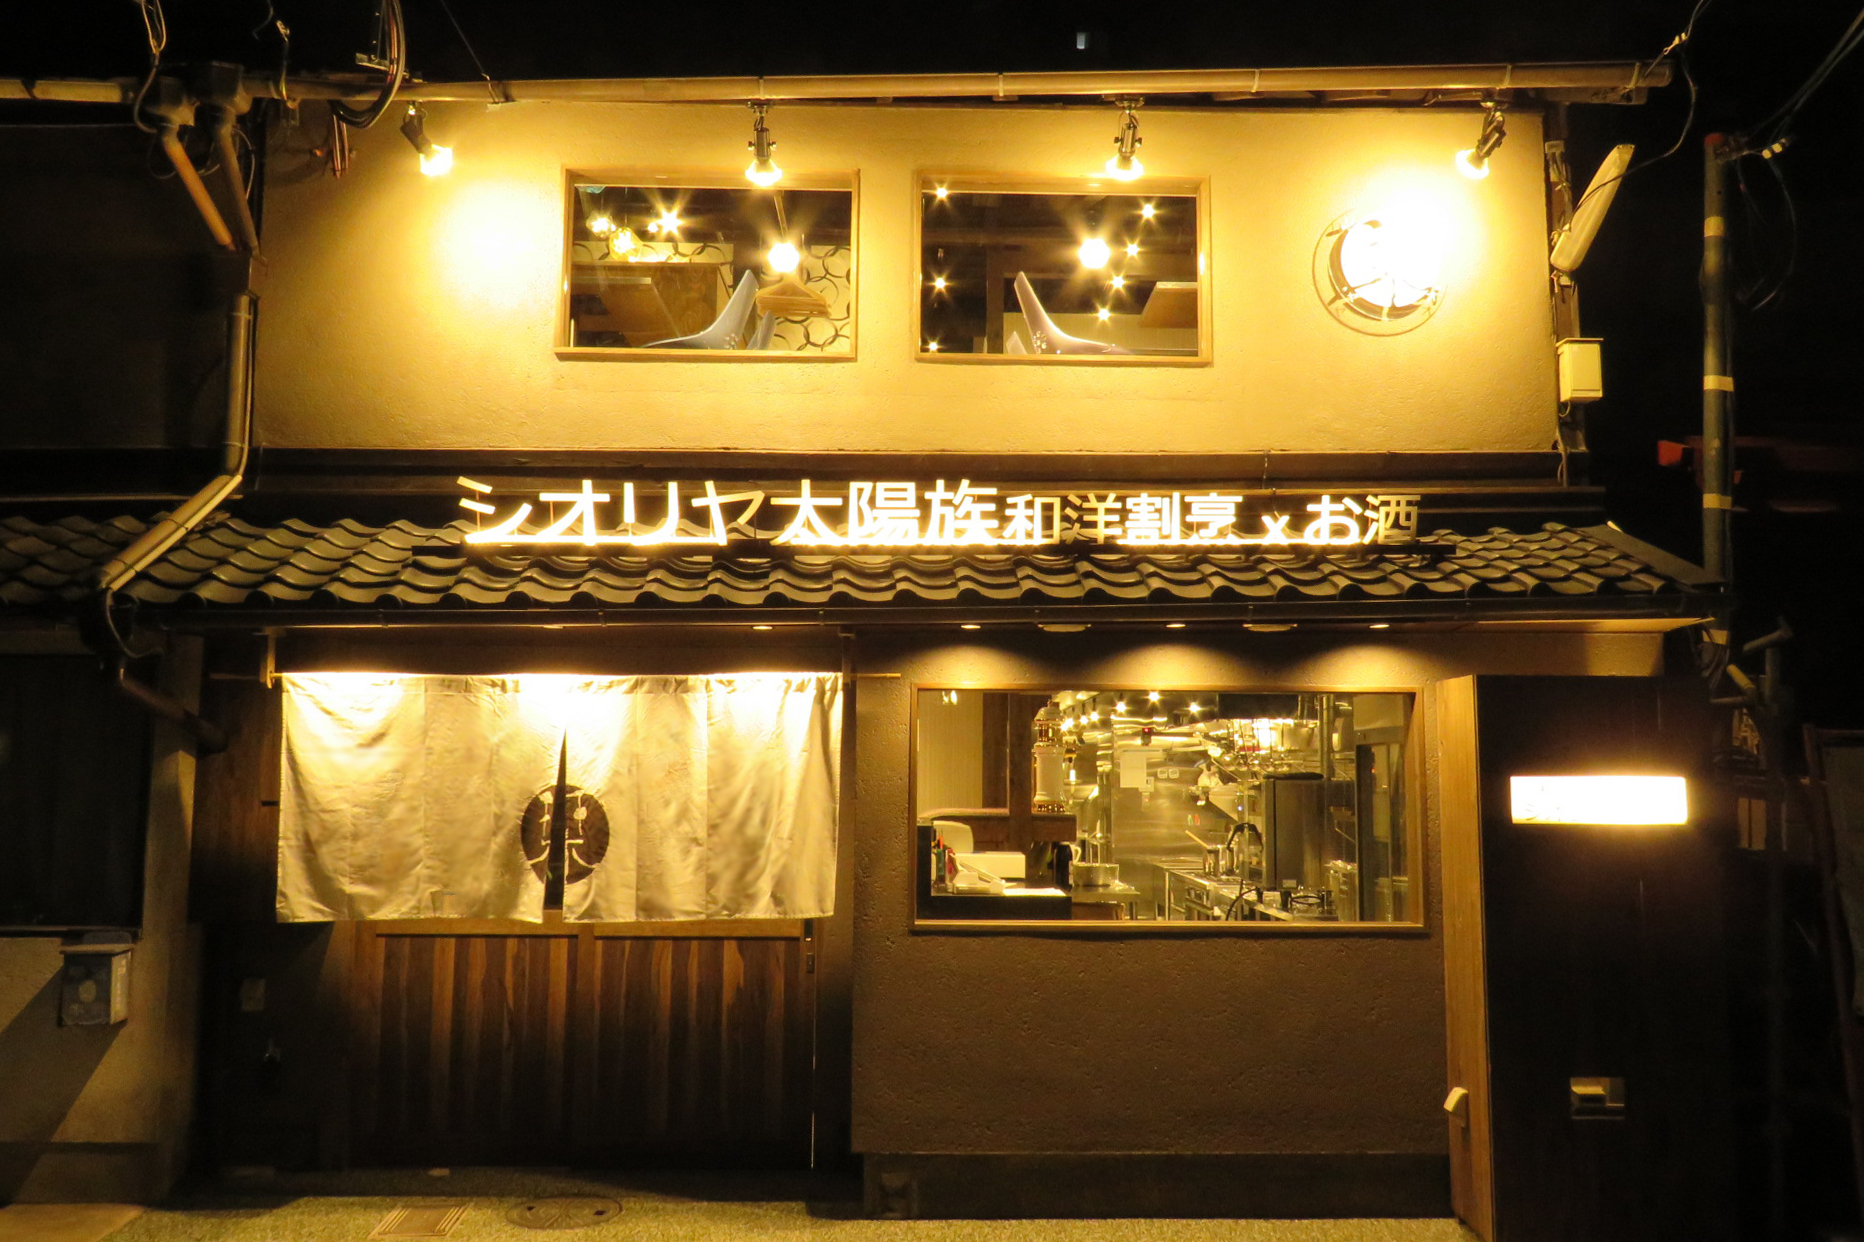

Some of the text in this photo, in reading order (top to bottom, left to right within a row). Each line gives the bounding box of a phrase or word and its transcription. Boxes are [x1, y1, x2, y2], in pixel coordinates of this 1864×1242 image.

[458, 475, 998, 546] シオリヤ太陽族
